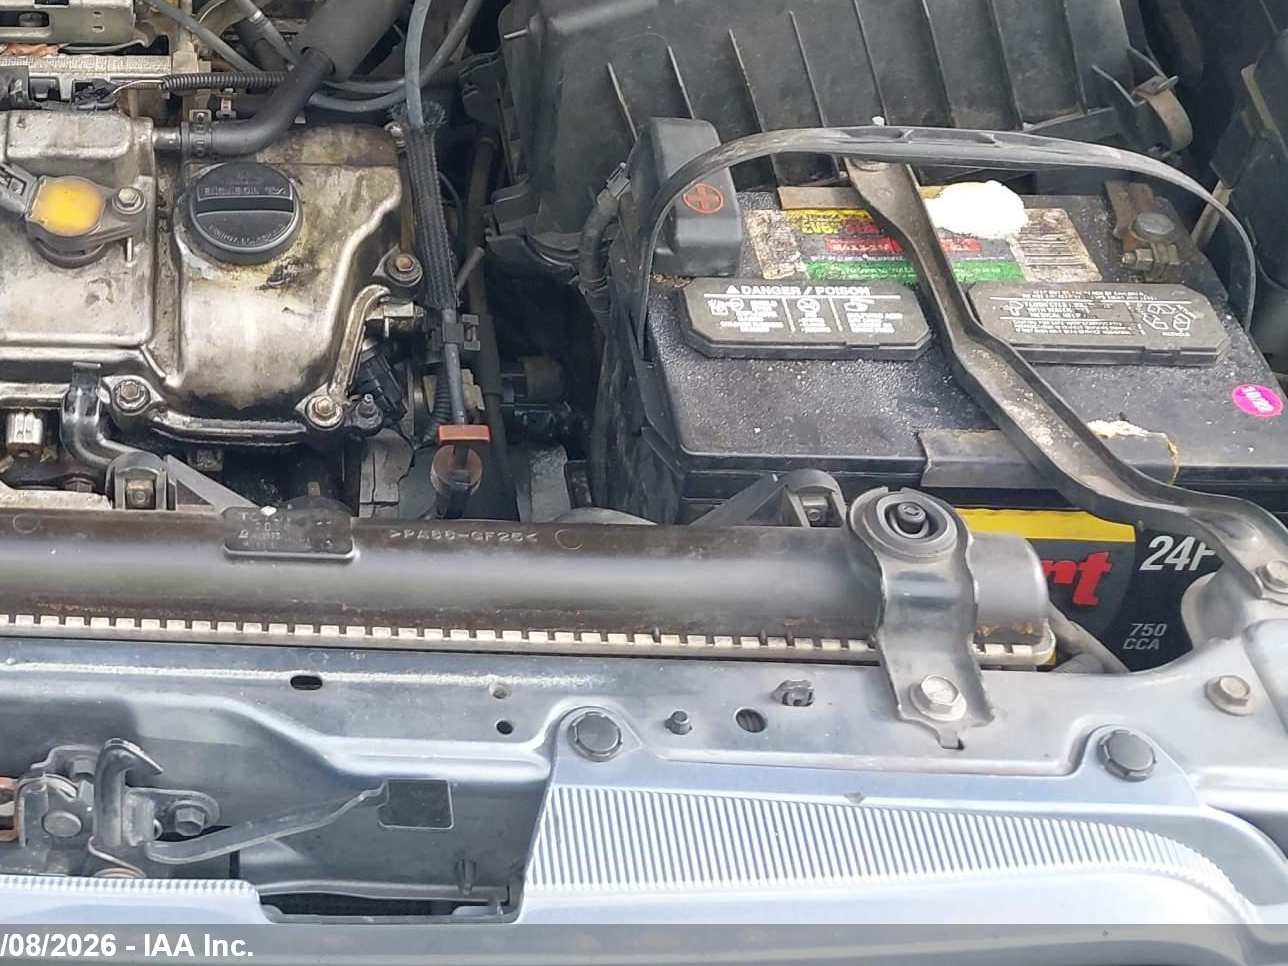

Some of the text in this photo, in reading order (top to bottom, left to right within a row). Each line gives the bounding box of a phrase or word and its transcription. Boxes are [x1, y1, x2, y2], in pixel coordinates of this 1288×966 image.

[742, 285, 801, 295] DANGER
[815, 286, 872, 296] POISON
[1130, 623, 1168, 637] 750
[1122, 638, 1161, 650] CCA
